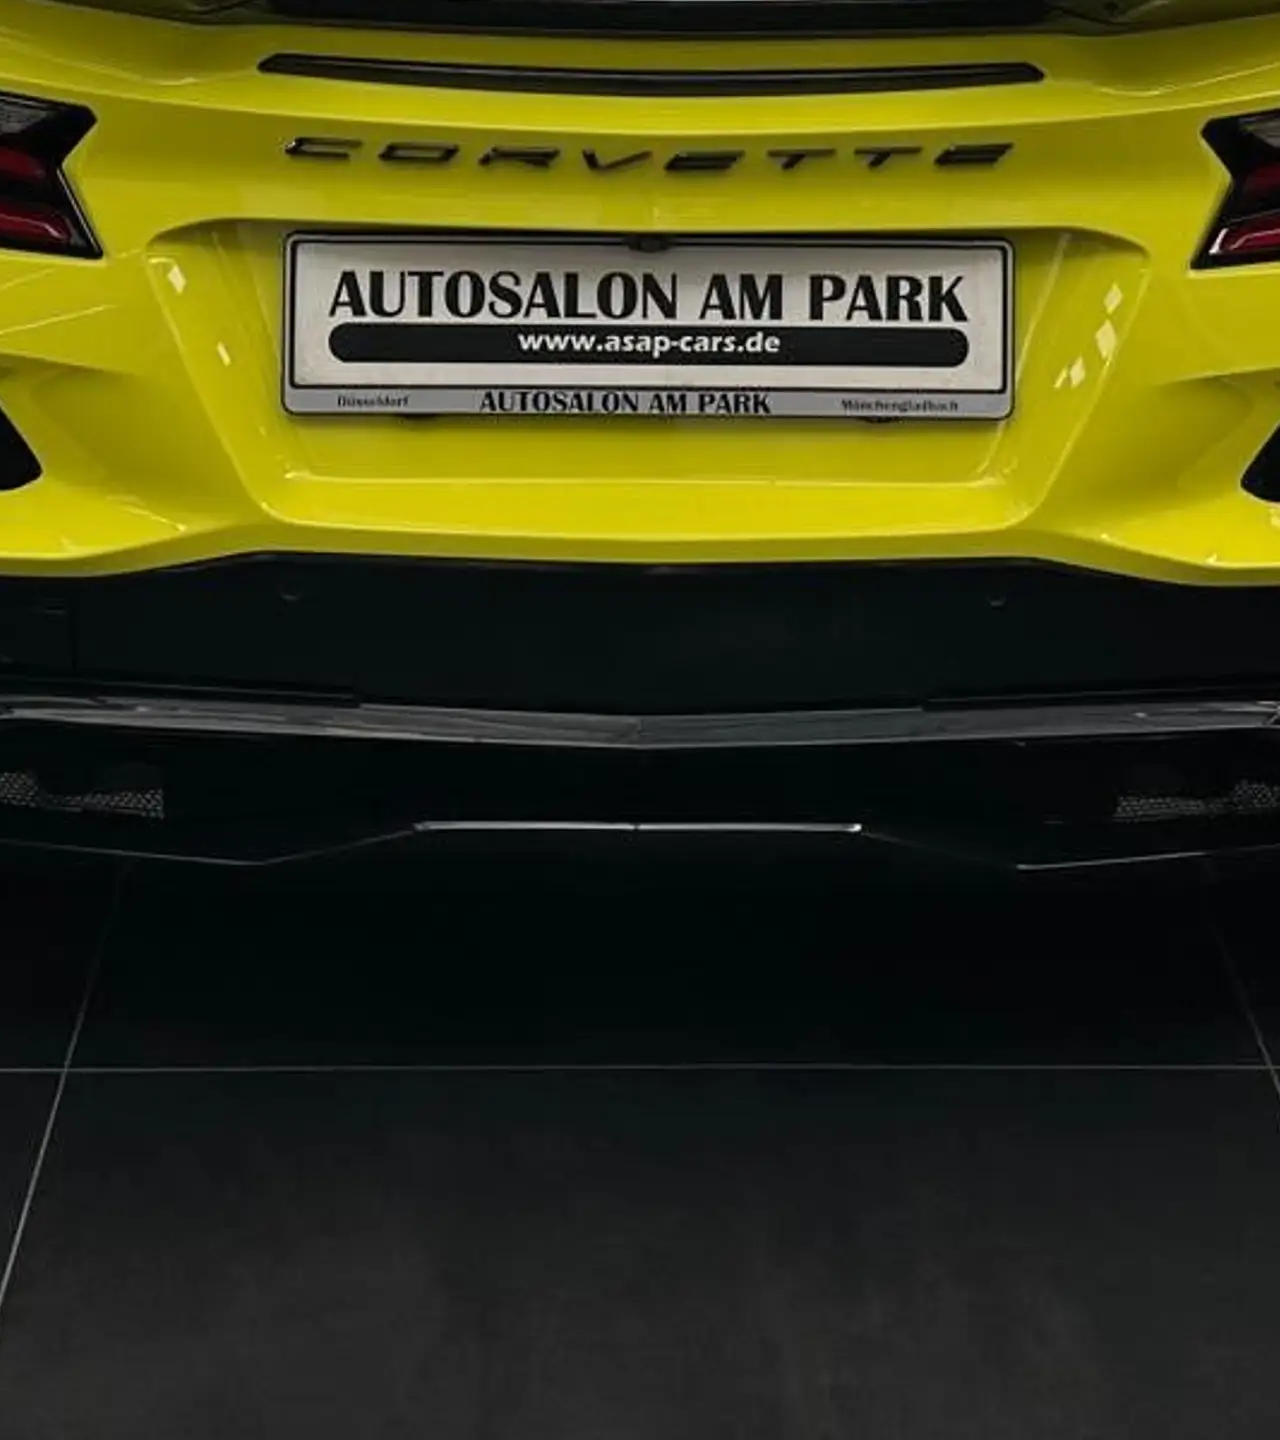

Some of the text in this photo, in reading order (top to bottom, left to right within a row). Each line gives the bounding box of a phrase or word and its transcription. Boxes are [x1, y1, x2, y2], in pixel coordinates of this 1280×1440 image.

[284, 136, 1015, 173] CORVETTE
[328, 270, 969, 322] AUTOSALON AM PARK
[518, 330, 781, 358] www.asap-cars.de
[479, 390, 772, 415] AUTOSALON AM PARK
